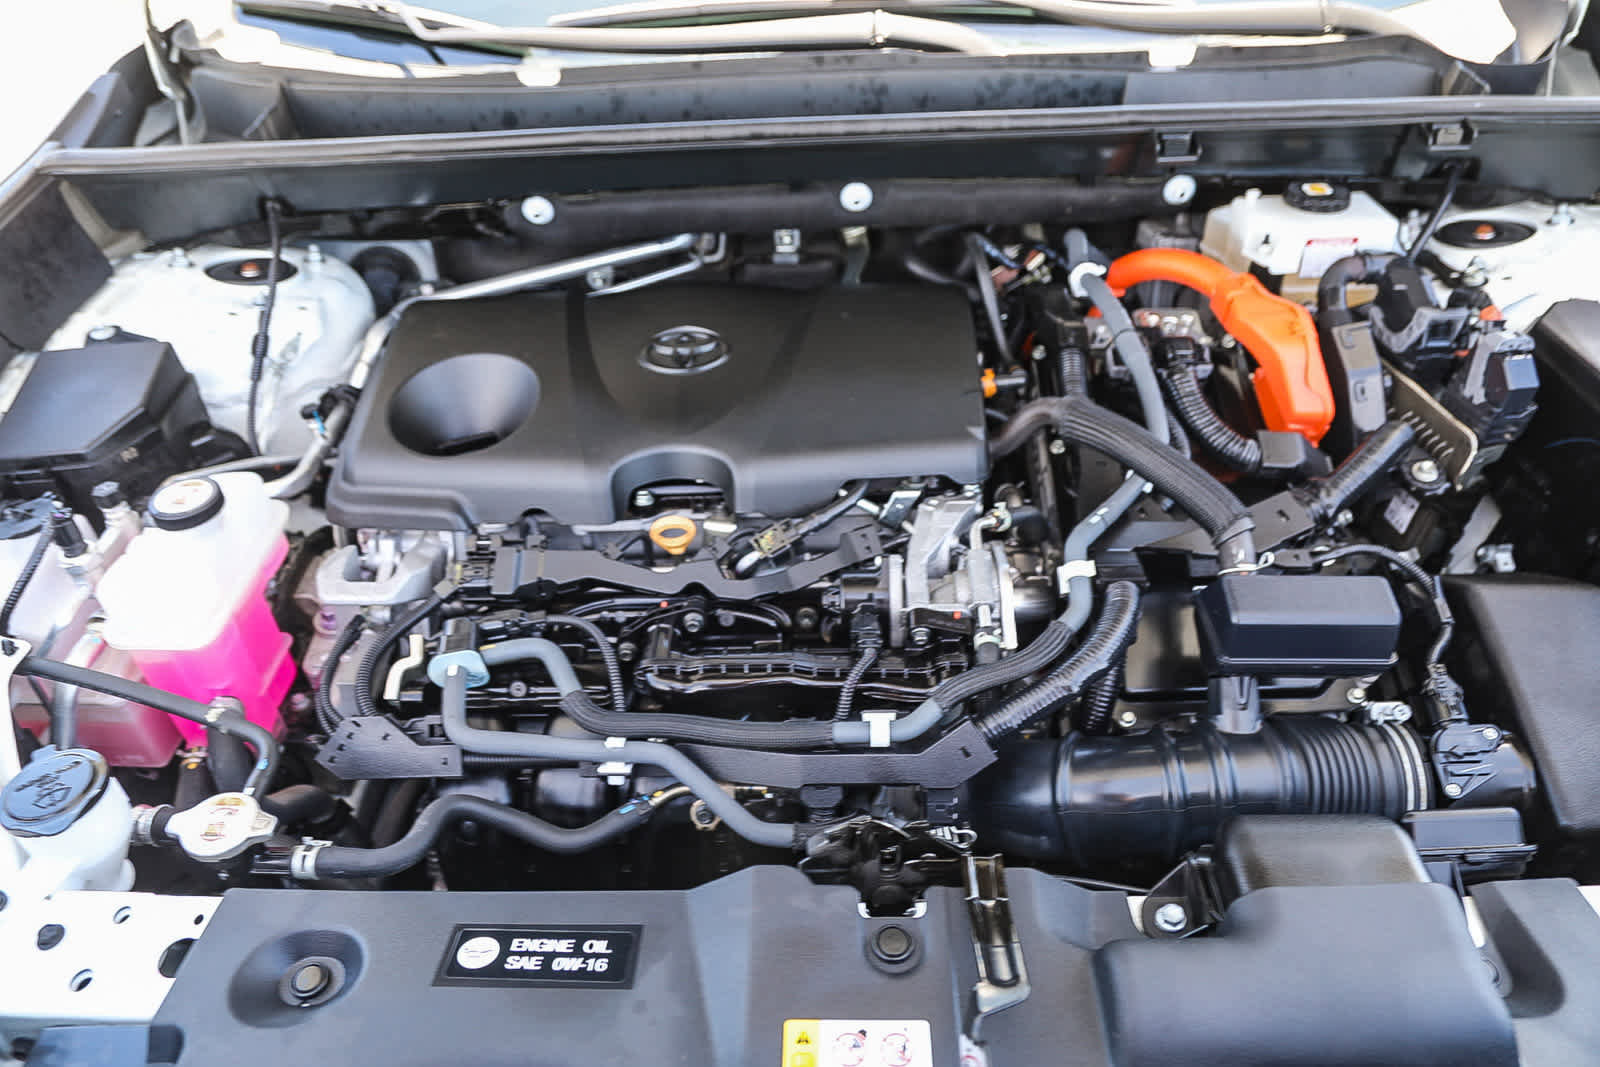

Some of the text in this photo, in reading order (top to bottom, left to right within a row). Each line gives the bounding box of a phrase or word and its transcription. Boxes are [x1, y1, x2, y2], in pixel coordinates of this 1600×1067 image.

[509, 938, 613, 954] ENGINE OIL
[504, 955, 609, 973] SAE 0W-16
